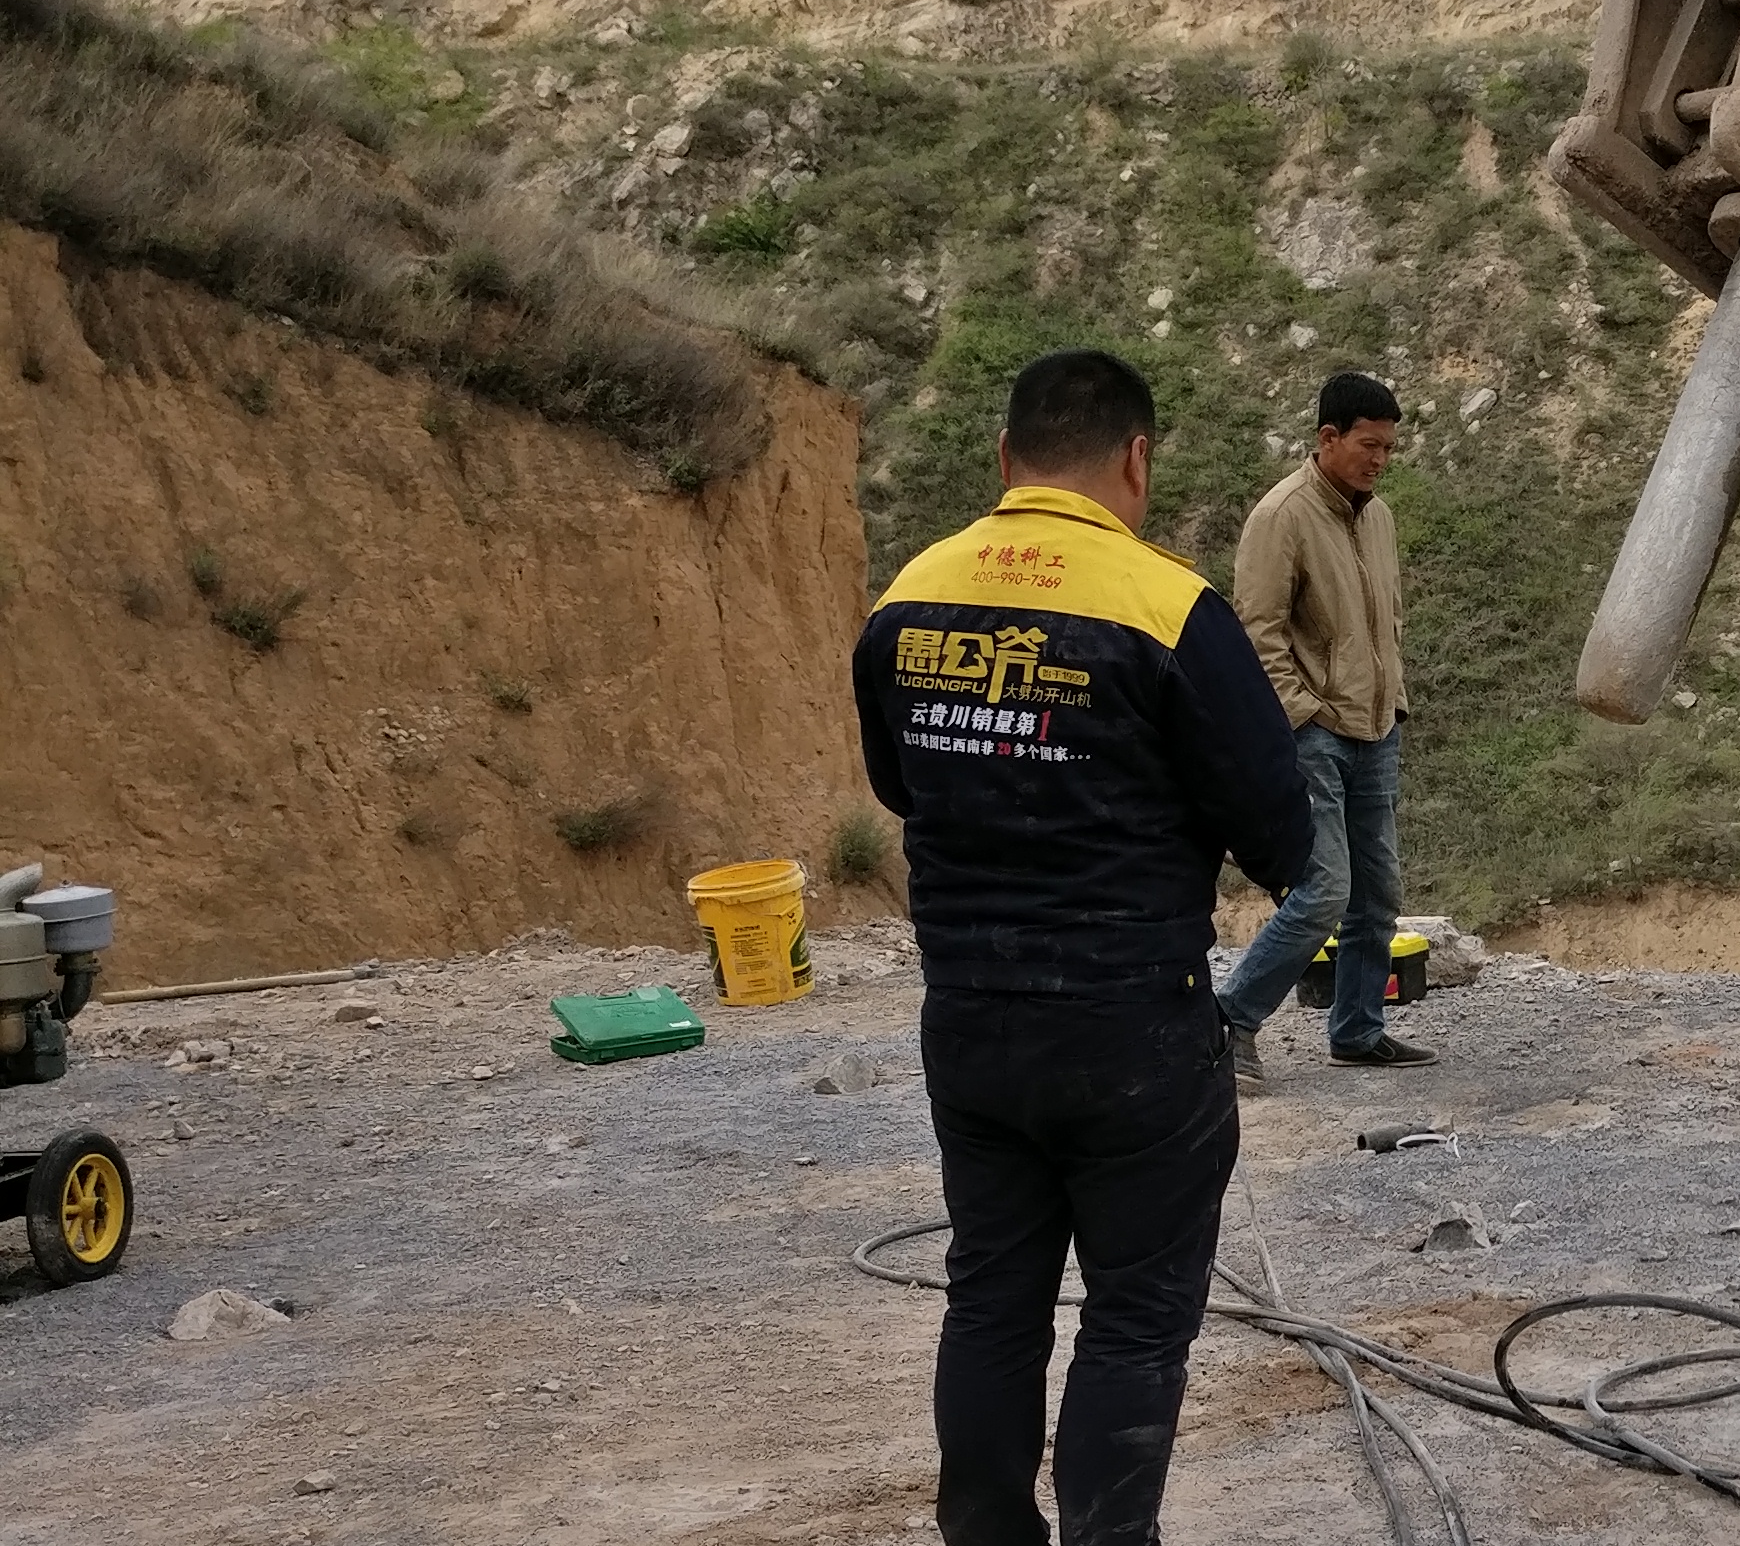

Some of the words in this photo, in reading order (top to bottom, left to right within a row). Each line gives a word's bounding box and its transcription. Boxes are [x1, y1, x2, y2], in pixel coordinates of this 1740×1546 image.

[977, 543, 1066, 570] 中德科工
[970, 570, 1063, 590] 400-990-7369
[896, 625, 1049, 703] 愚公斧
[894, 673, 988, 694] YUGONGFU
[1002, 682, 1093, 709] 大劈力开山机
